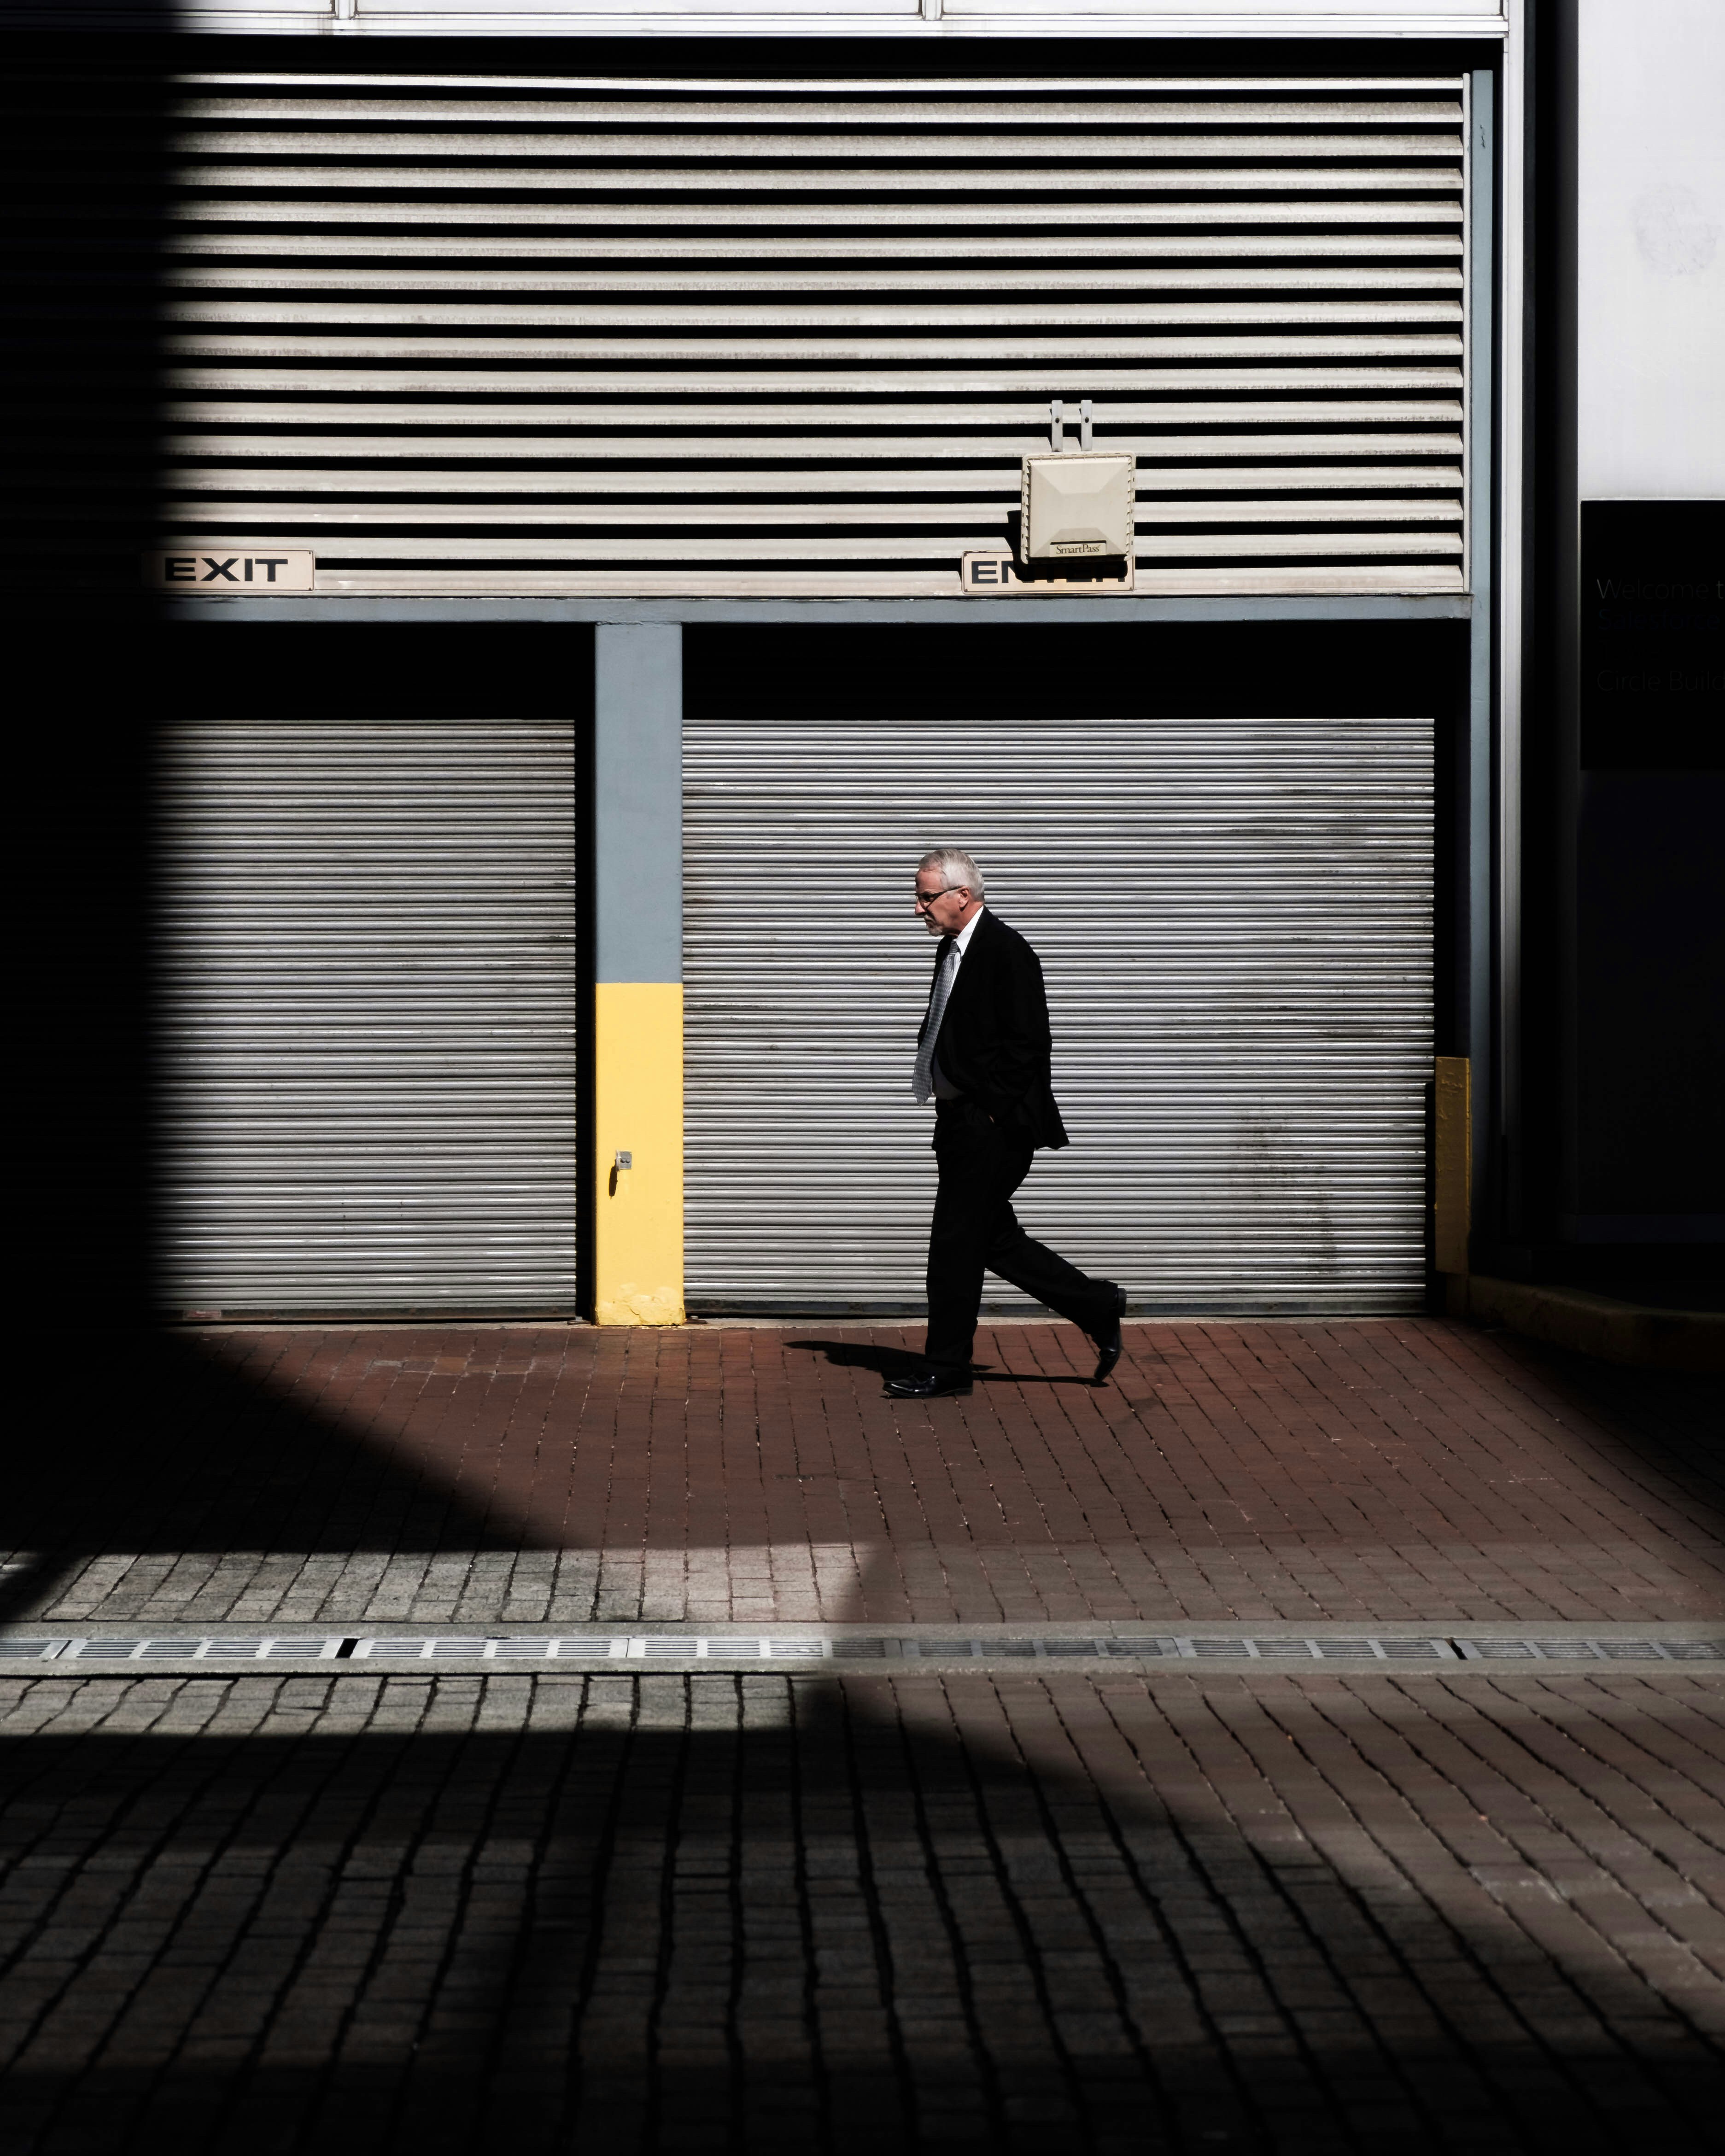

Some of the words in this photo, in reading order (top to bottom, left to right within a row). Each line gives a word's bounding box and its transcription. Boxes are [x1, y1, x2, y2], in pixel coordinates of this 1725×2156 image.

[1056, 544, 1099, 554] SmartPass
[165, 557, 288, 582] EXIT
[1596, 578, 1709, 599] Welcome
[1716, 580, 1725, 599] t
[1597, 671, 1661, 691] Circle
